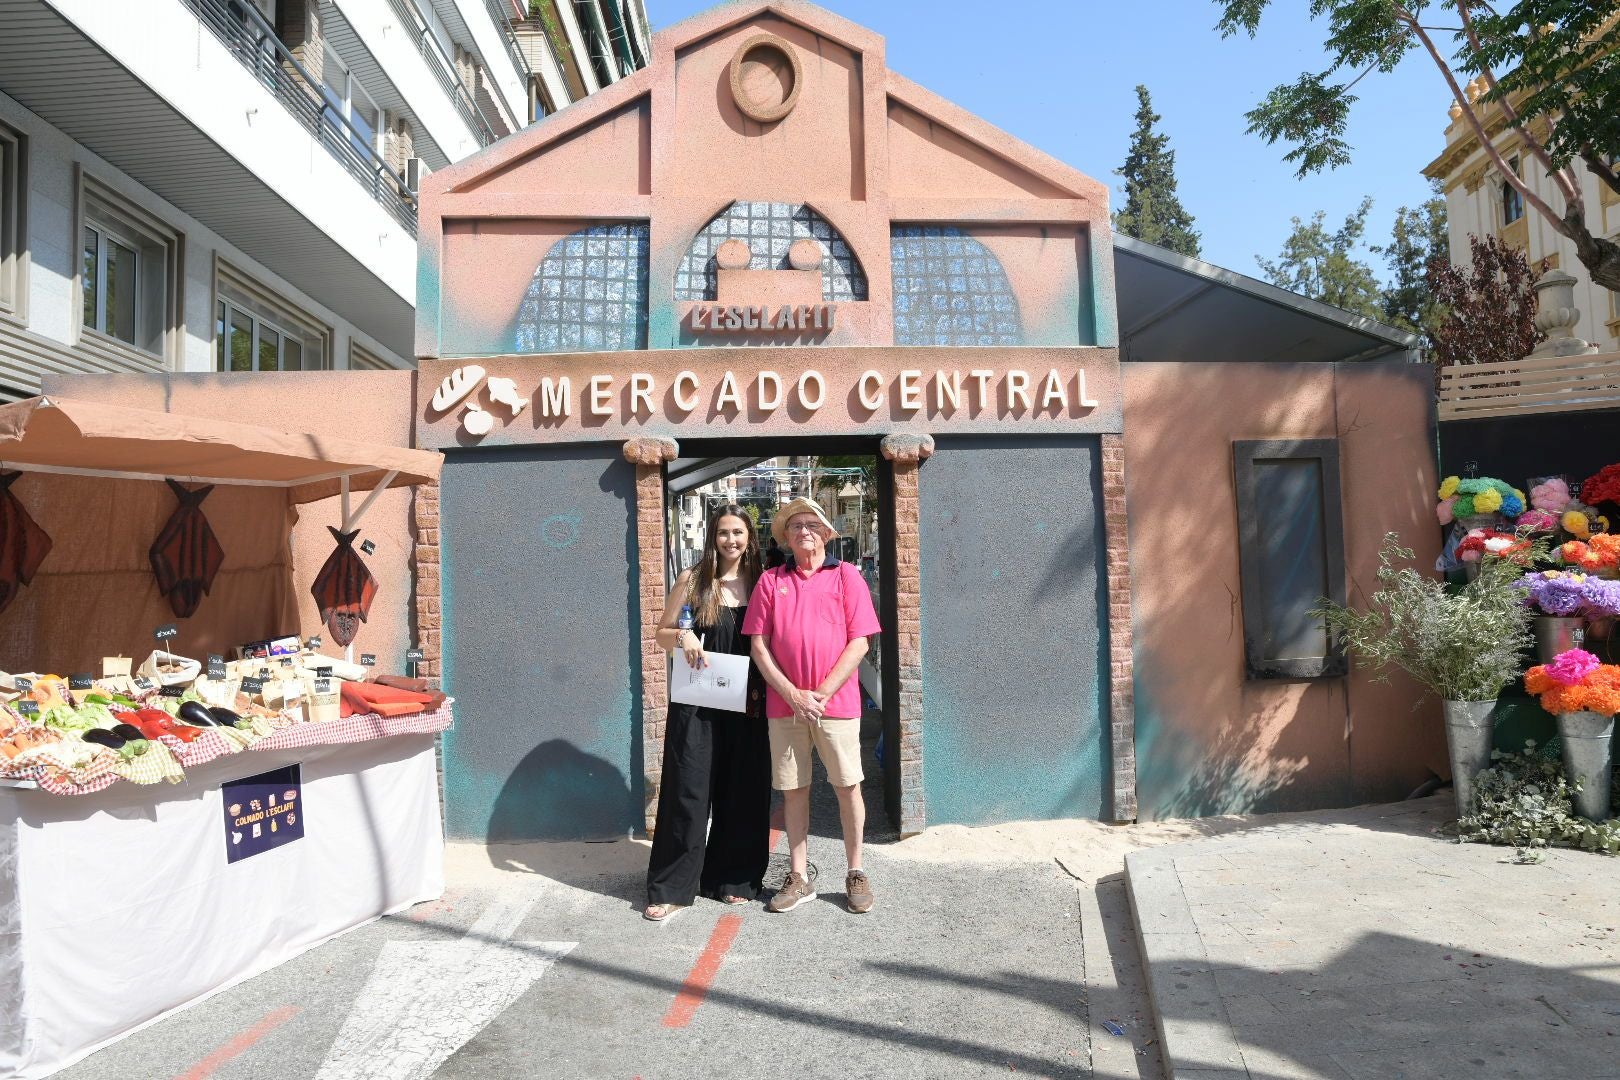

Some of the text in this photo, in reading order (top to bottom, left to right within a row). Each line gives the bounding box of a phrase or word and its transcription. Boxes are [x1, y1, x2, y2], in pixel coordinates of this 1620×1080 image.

[691, 304, 838, 330] L'ESCLAFIT
[541, 367, 1099, 418] MERCADO CENTRAL
